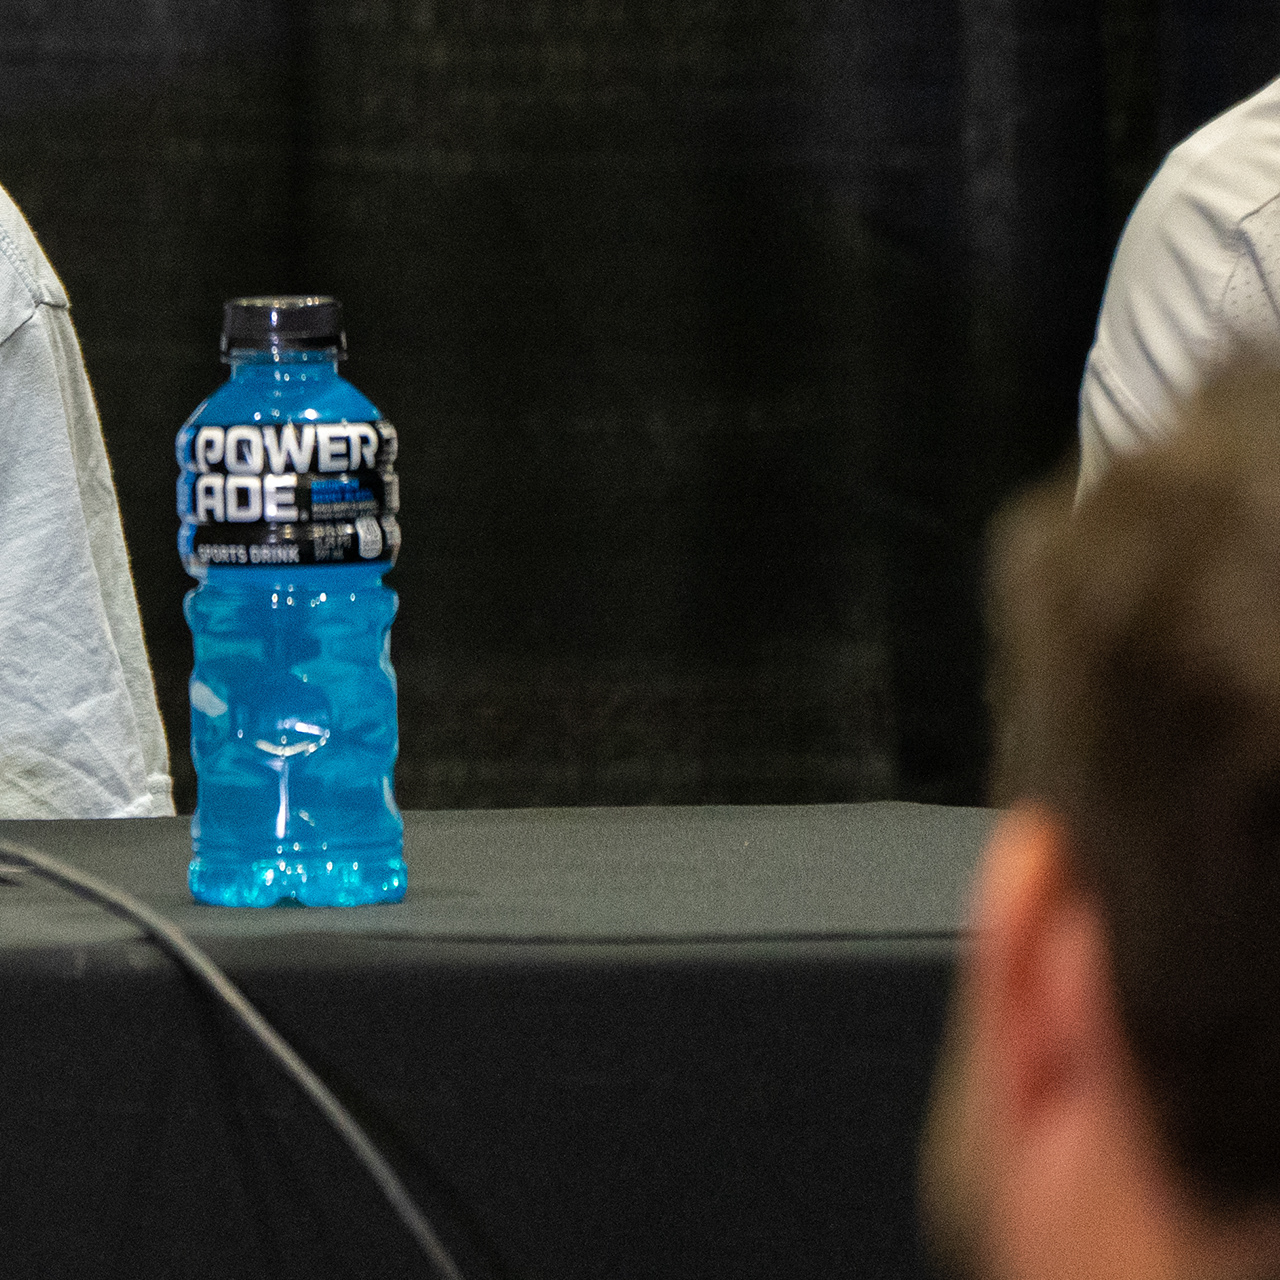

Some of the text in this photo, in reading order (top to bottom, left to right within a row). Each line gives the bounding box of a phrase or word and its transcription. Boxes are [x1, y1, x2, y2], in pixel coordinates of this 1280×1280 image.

[196, 422, 378, 474] POWER
[196, 472, 298, 522] ADE
[198, 544, 299, 563] SPORTS DRINK
